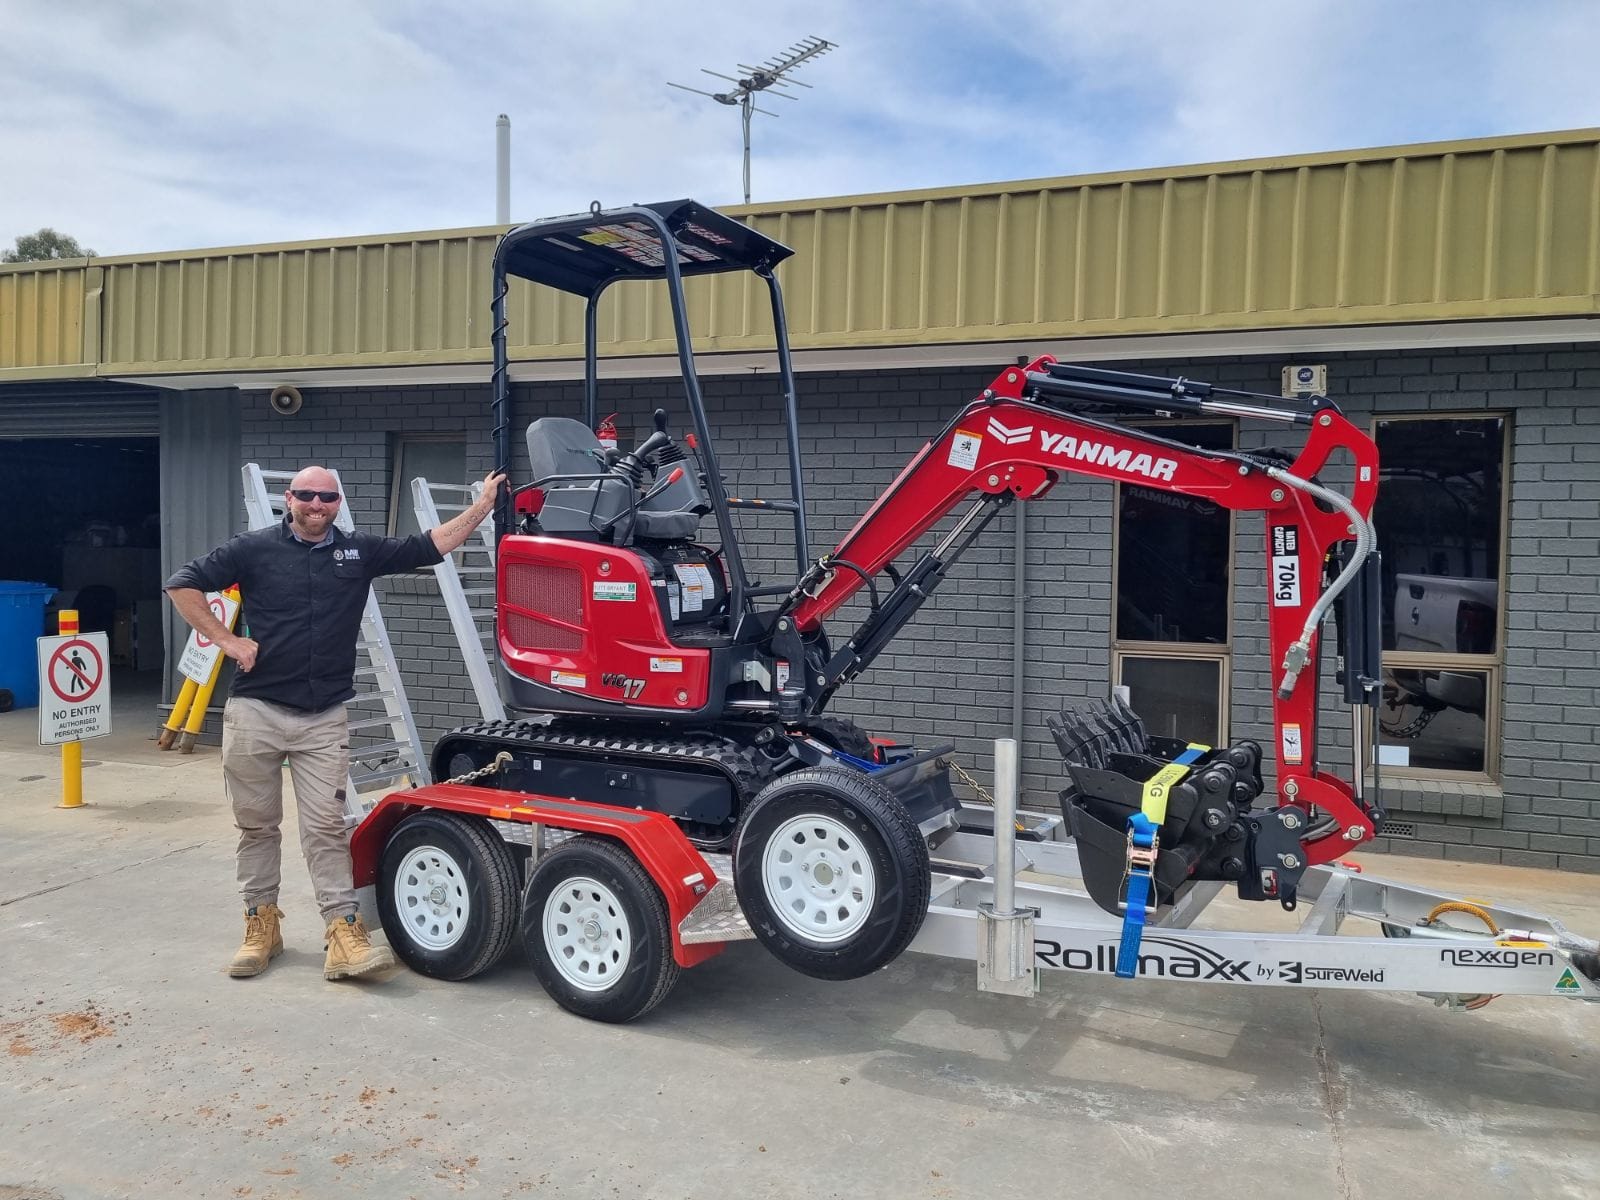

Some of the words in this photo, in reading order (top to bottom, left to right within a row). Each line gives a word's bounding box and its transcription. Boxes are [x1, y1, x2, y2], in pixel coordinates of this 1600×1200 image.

[1040, 430, 1178, 481] YANMAR
[1274, 526, 1285, 555] CAPACITY
[1285, 530, 1296, 550] RATED
[1275, 562, 1296, 600] 70kg
[52, 710, 67, 720] NO
[70, 704, 102, 718] ENTRY
[54, 727, 84, 738] PERSONS
[85, 725, 100, 733] ONLY
[58, 717, 97, 729] AUTHORISED
[1441, 949, 1553, 969] nexxgen
[1257, 964, 1274, 980] by
[1305, 966, 1384, 983] SureWeld
